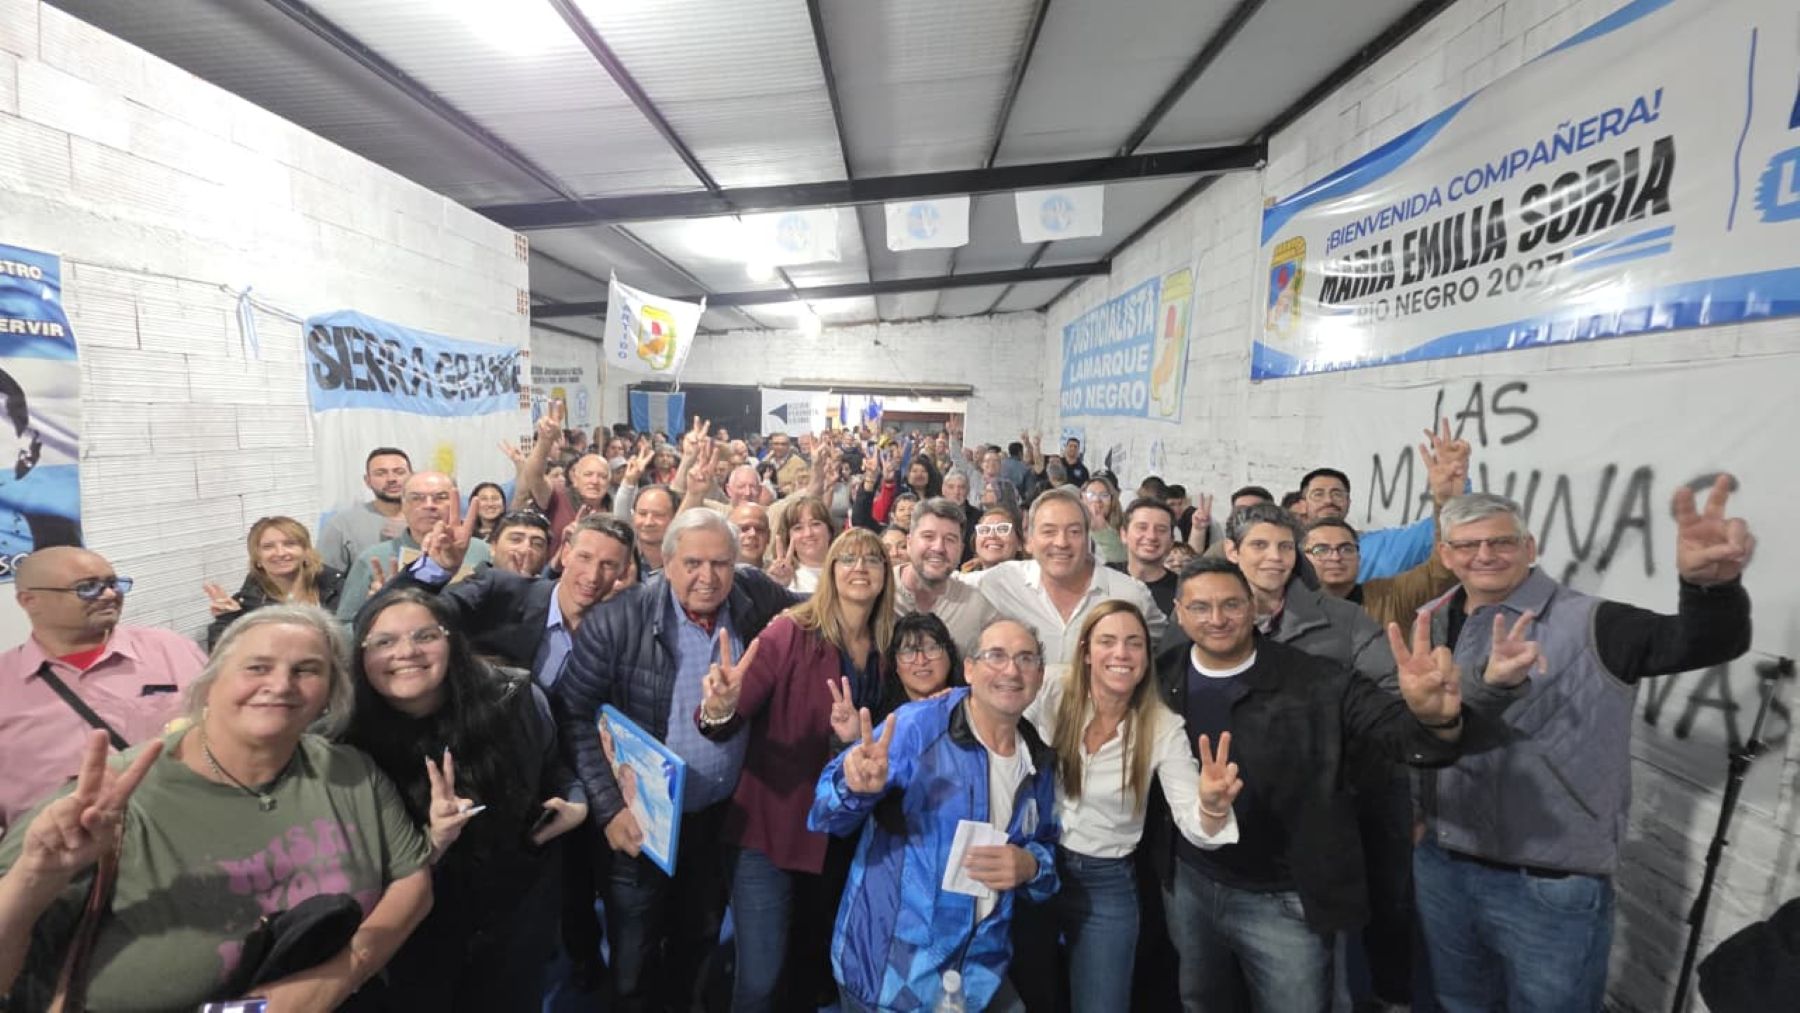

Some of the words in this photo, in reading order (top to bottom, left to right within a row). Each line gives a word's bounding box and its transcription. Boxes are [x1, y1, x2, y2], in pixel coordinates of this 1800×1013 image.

[1326, 187, 1442, 254] ¡BIENVENIDA
[1447, 87, 1664, 202] COMPAÑERA!
[1401, 198, 1507, 286] EMILIA
[1518, 135, 1676, 253] SORIA
[1069, 283, 1155, 354] JUSTICIALISTA
[1395, 275, 1480, 319] NEGRO
[1487, 252, 1565, 297] 2027
[308, 324, 432, 399] SIERRA
[1062, 386, 1082, 411] RIO
[1085, 380, 1147, 411] NEGRO
[1070, 343, 1150, 383] LAMARQUE
